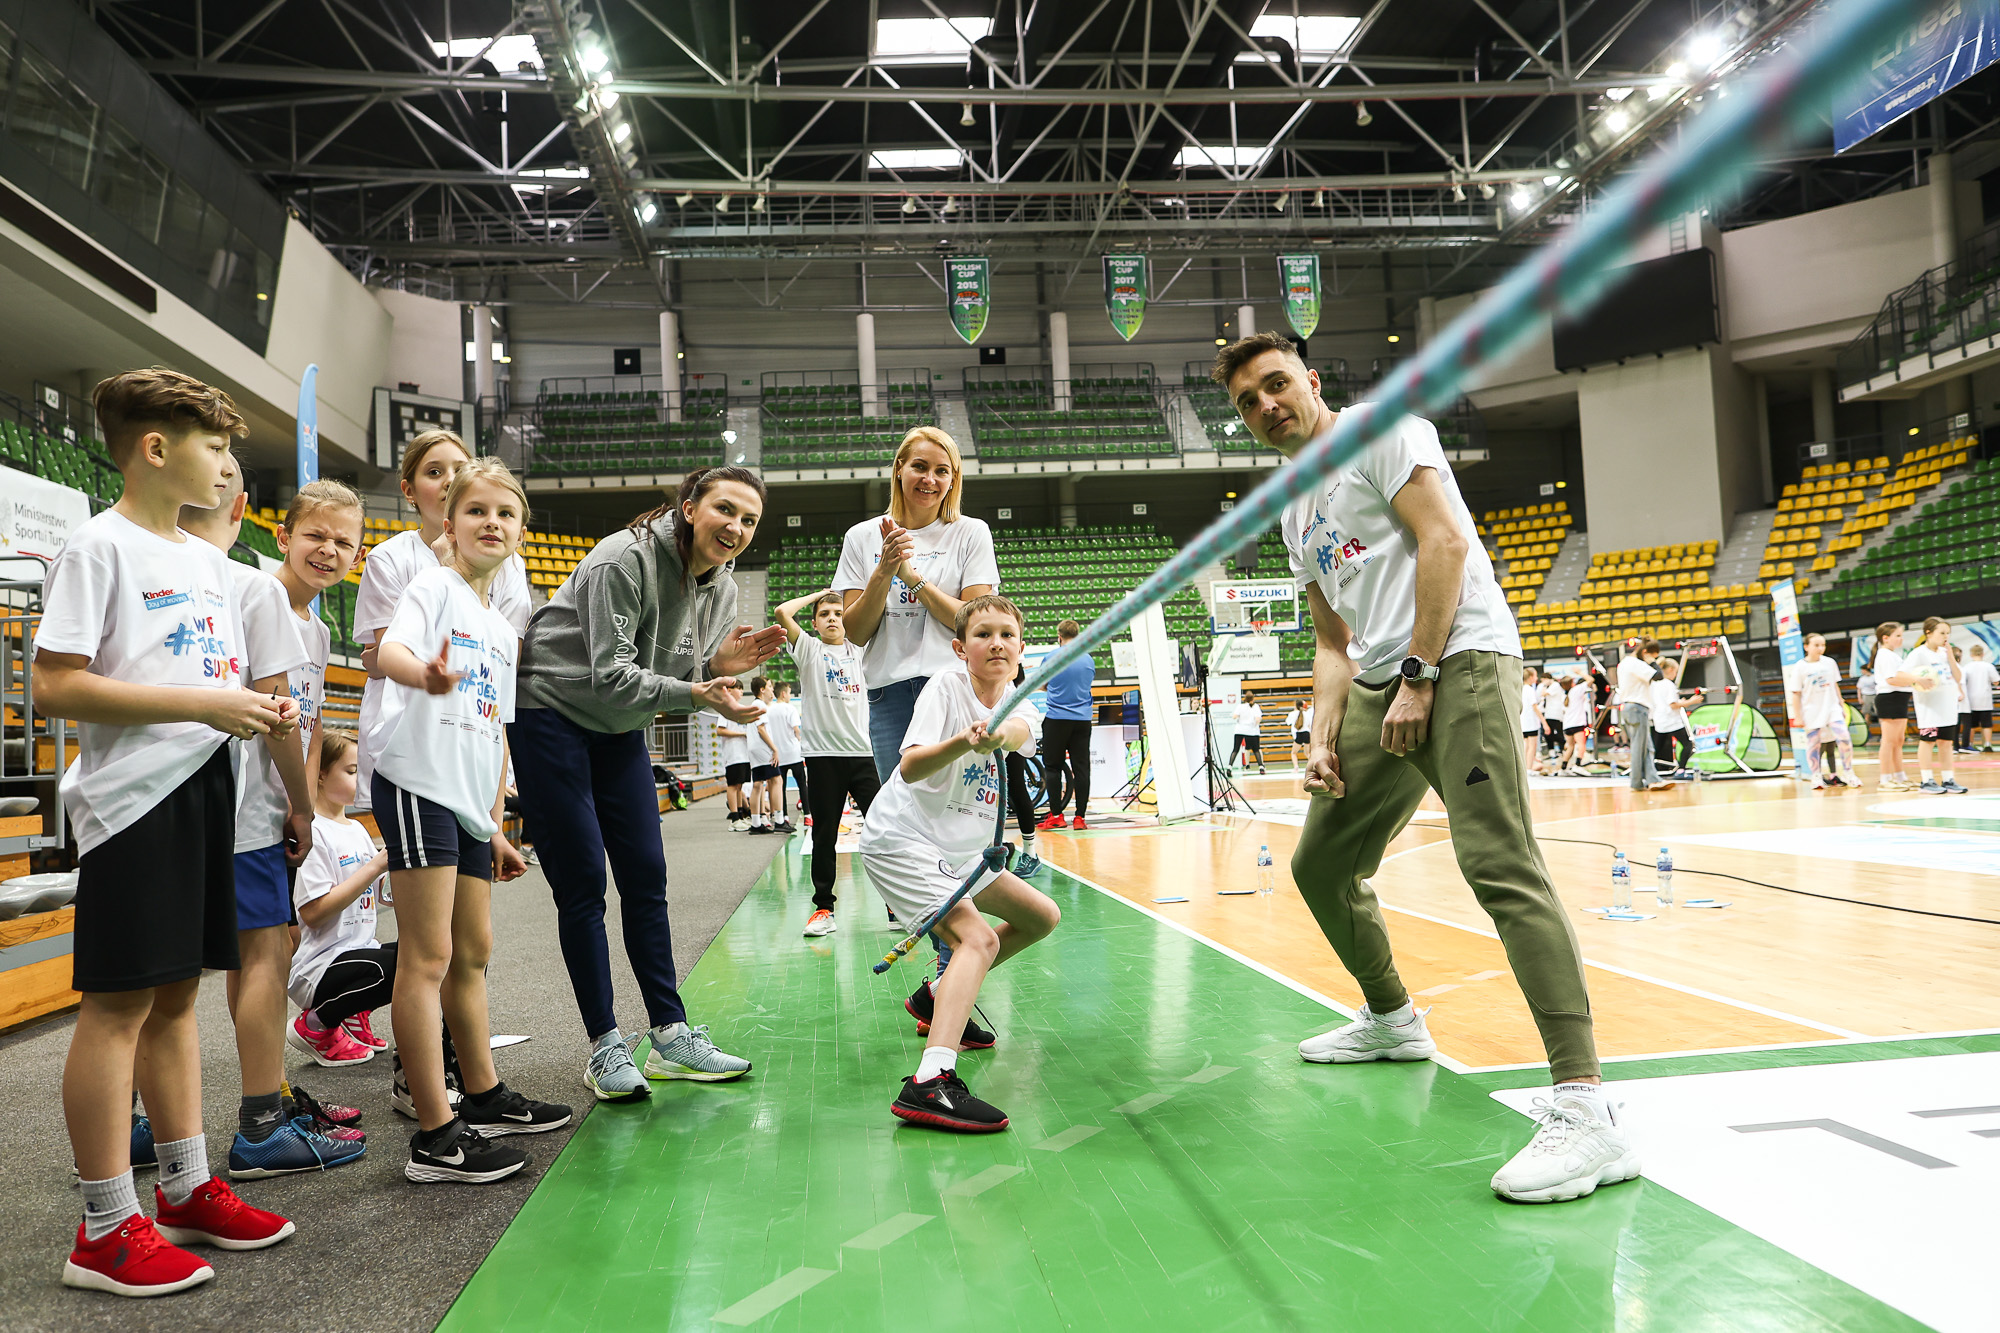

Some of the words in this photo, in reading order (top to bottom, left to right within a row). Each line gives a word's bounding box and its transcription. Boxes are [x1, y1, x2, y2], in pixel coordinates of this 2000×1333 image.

[1114, 276, 1136, 284] 2017
[1289, 275, 1310, 284] 2021
[956, 281, 979, 289] 2015
[14, 502, 68, 529] Ministerstwo
[789, 517, 799, 525] C1
[1240, 588, 1287, 598] SUZUKI
